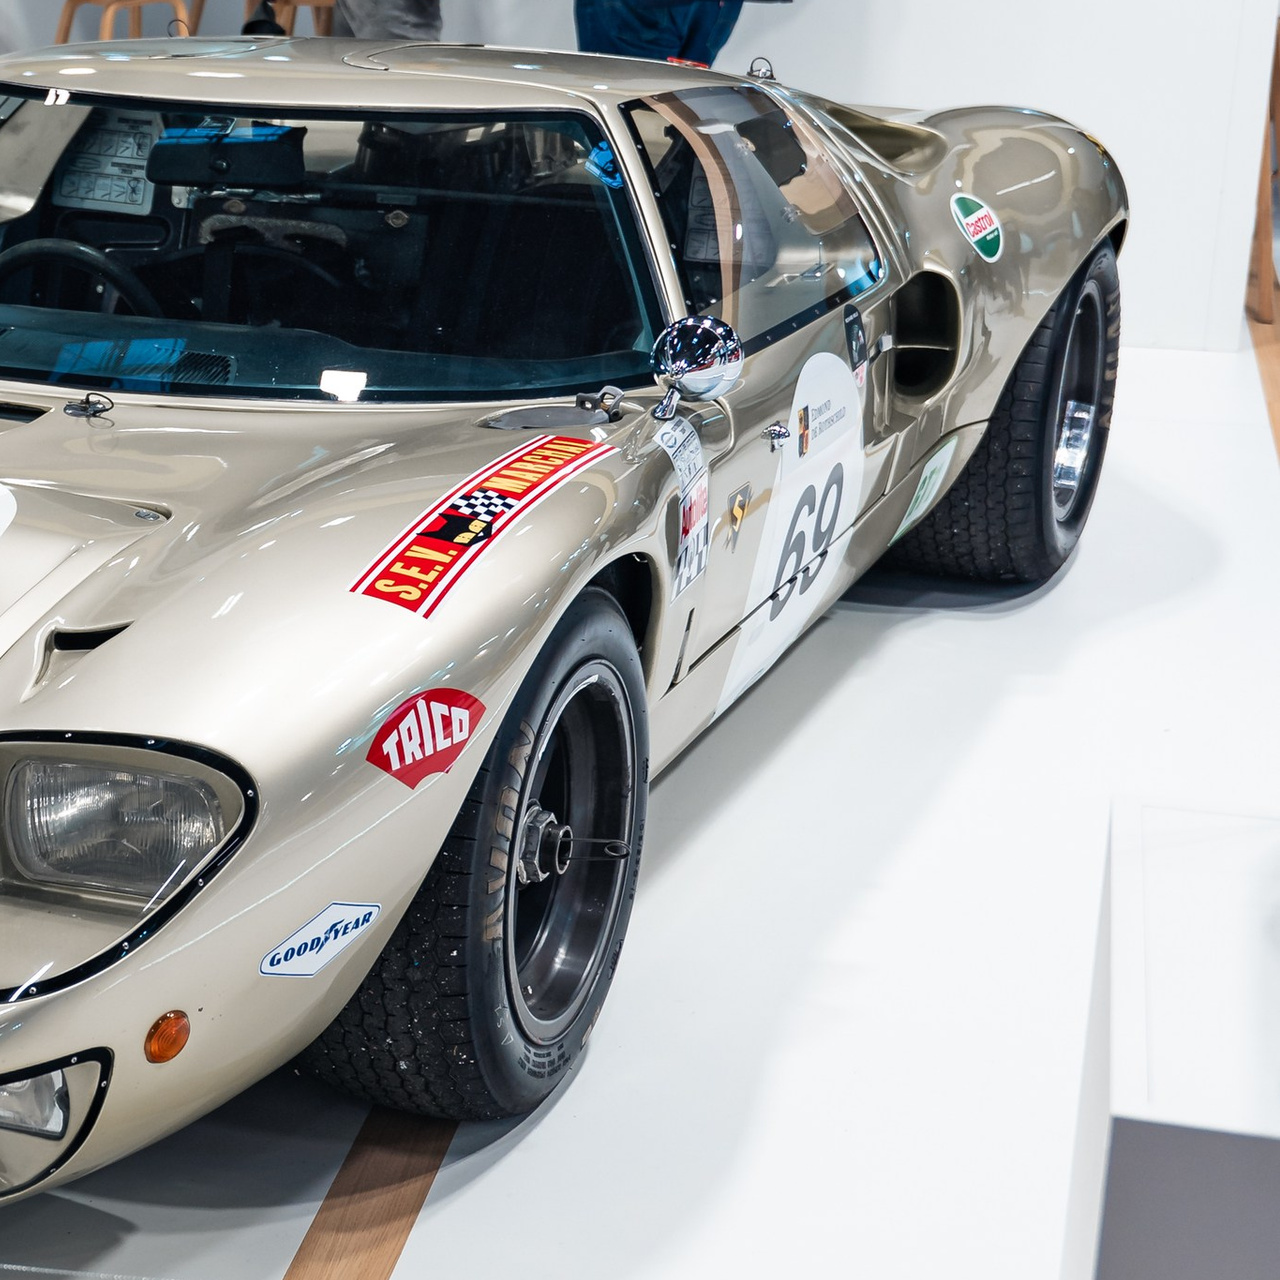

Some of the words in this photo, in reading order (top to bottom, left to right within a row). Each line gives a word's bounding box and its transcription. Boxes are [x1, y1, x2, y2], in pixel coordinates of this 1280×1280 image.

[965, 210, 995, 238] Castrol
[374, 545, 458, 601] S.E.V.
[482, 439, 595, 494] MARCHAL
[770, 462, 843, 622] 69
[382, 699, 470, 771] TRICO
[269, 911, 373, 967] GOODYEAR
